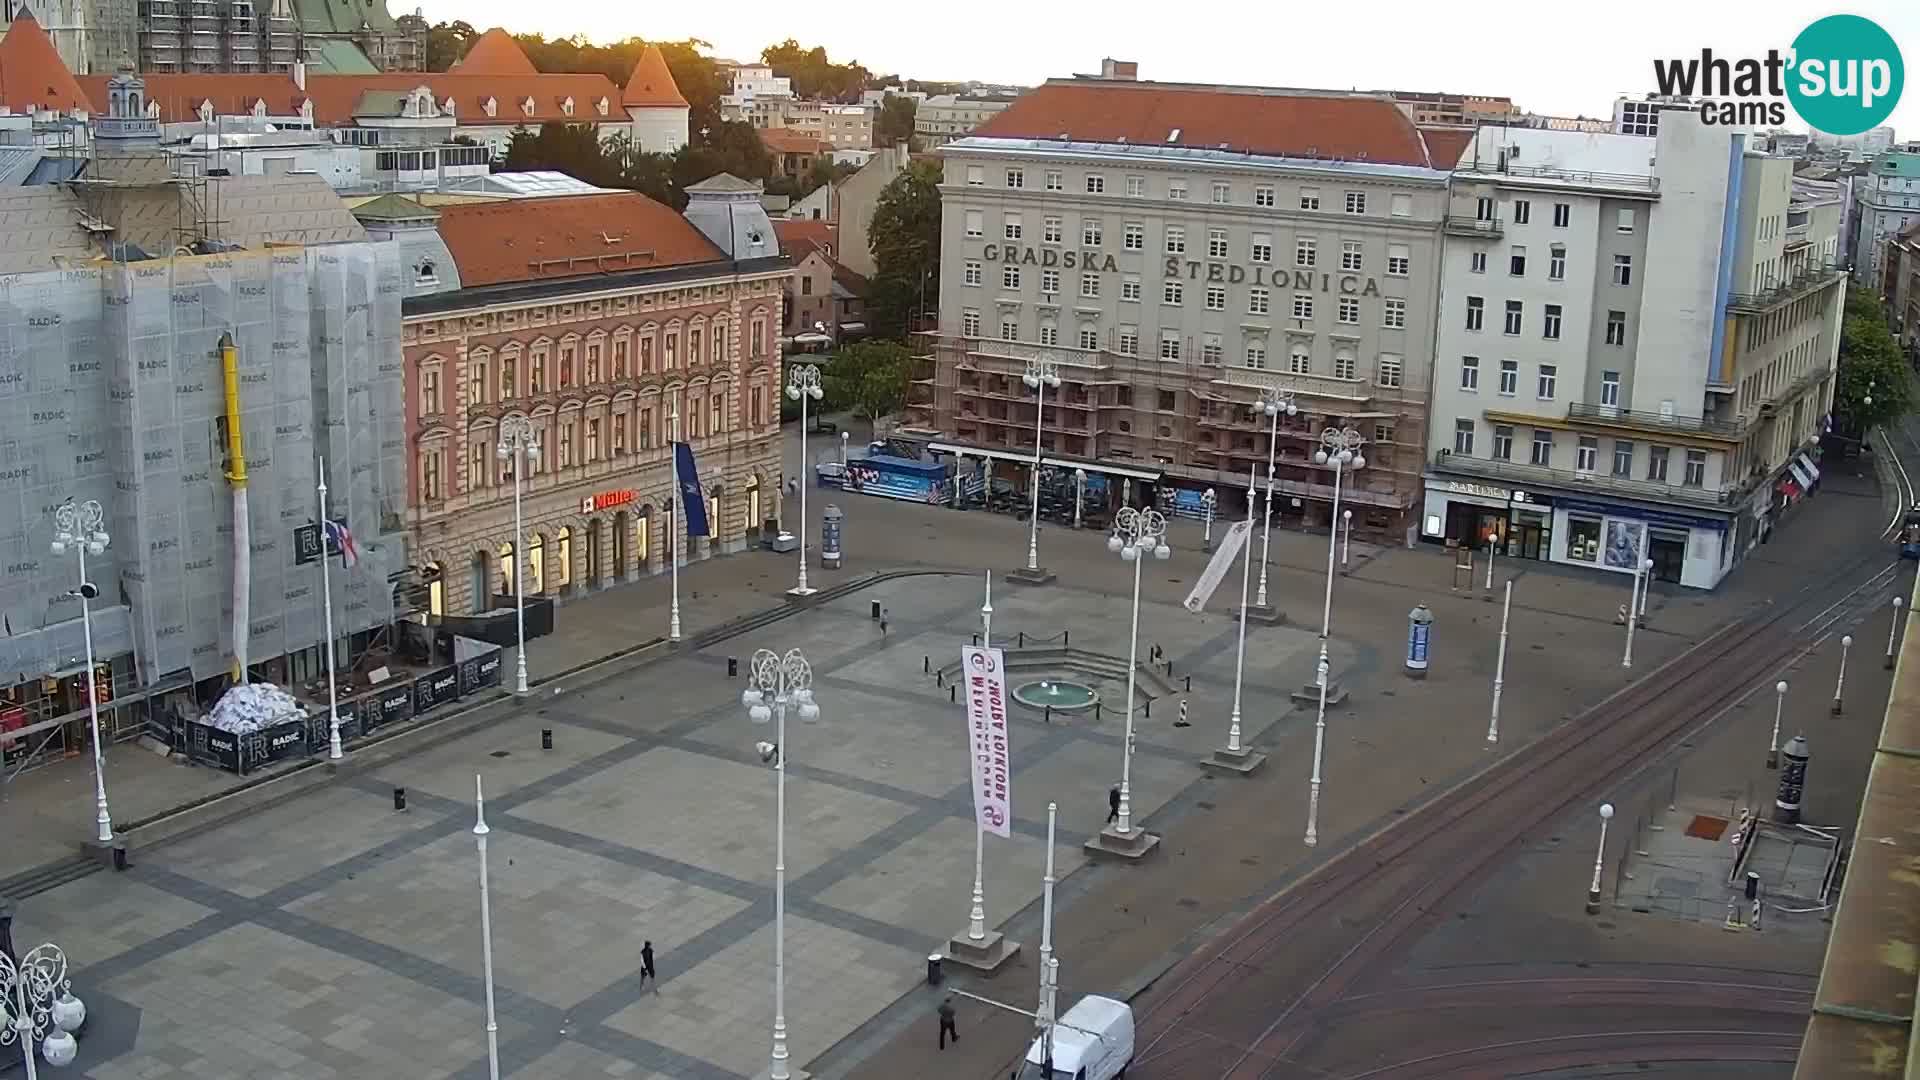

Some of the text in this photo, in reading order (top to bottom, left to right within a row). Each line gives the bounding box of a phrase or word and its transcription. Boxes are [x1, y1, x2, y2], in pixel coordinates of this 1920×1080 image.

[983, 244, 1380, 297] GRADSKA ŠTEDIONICA
[596, 489, 639, 509] Müller
